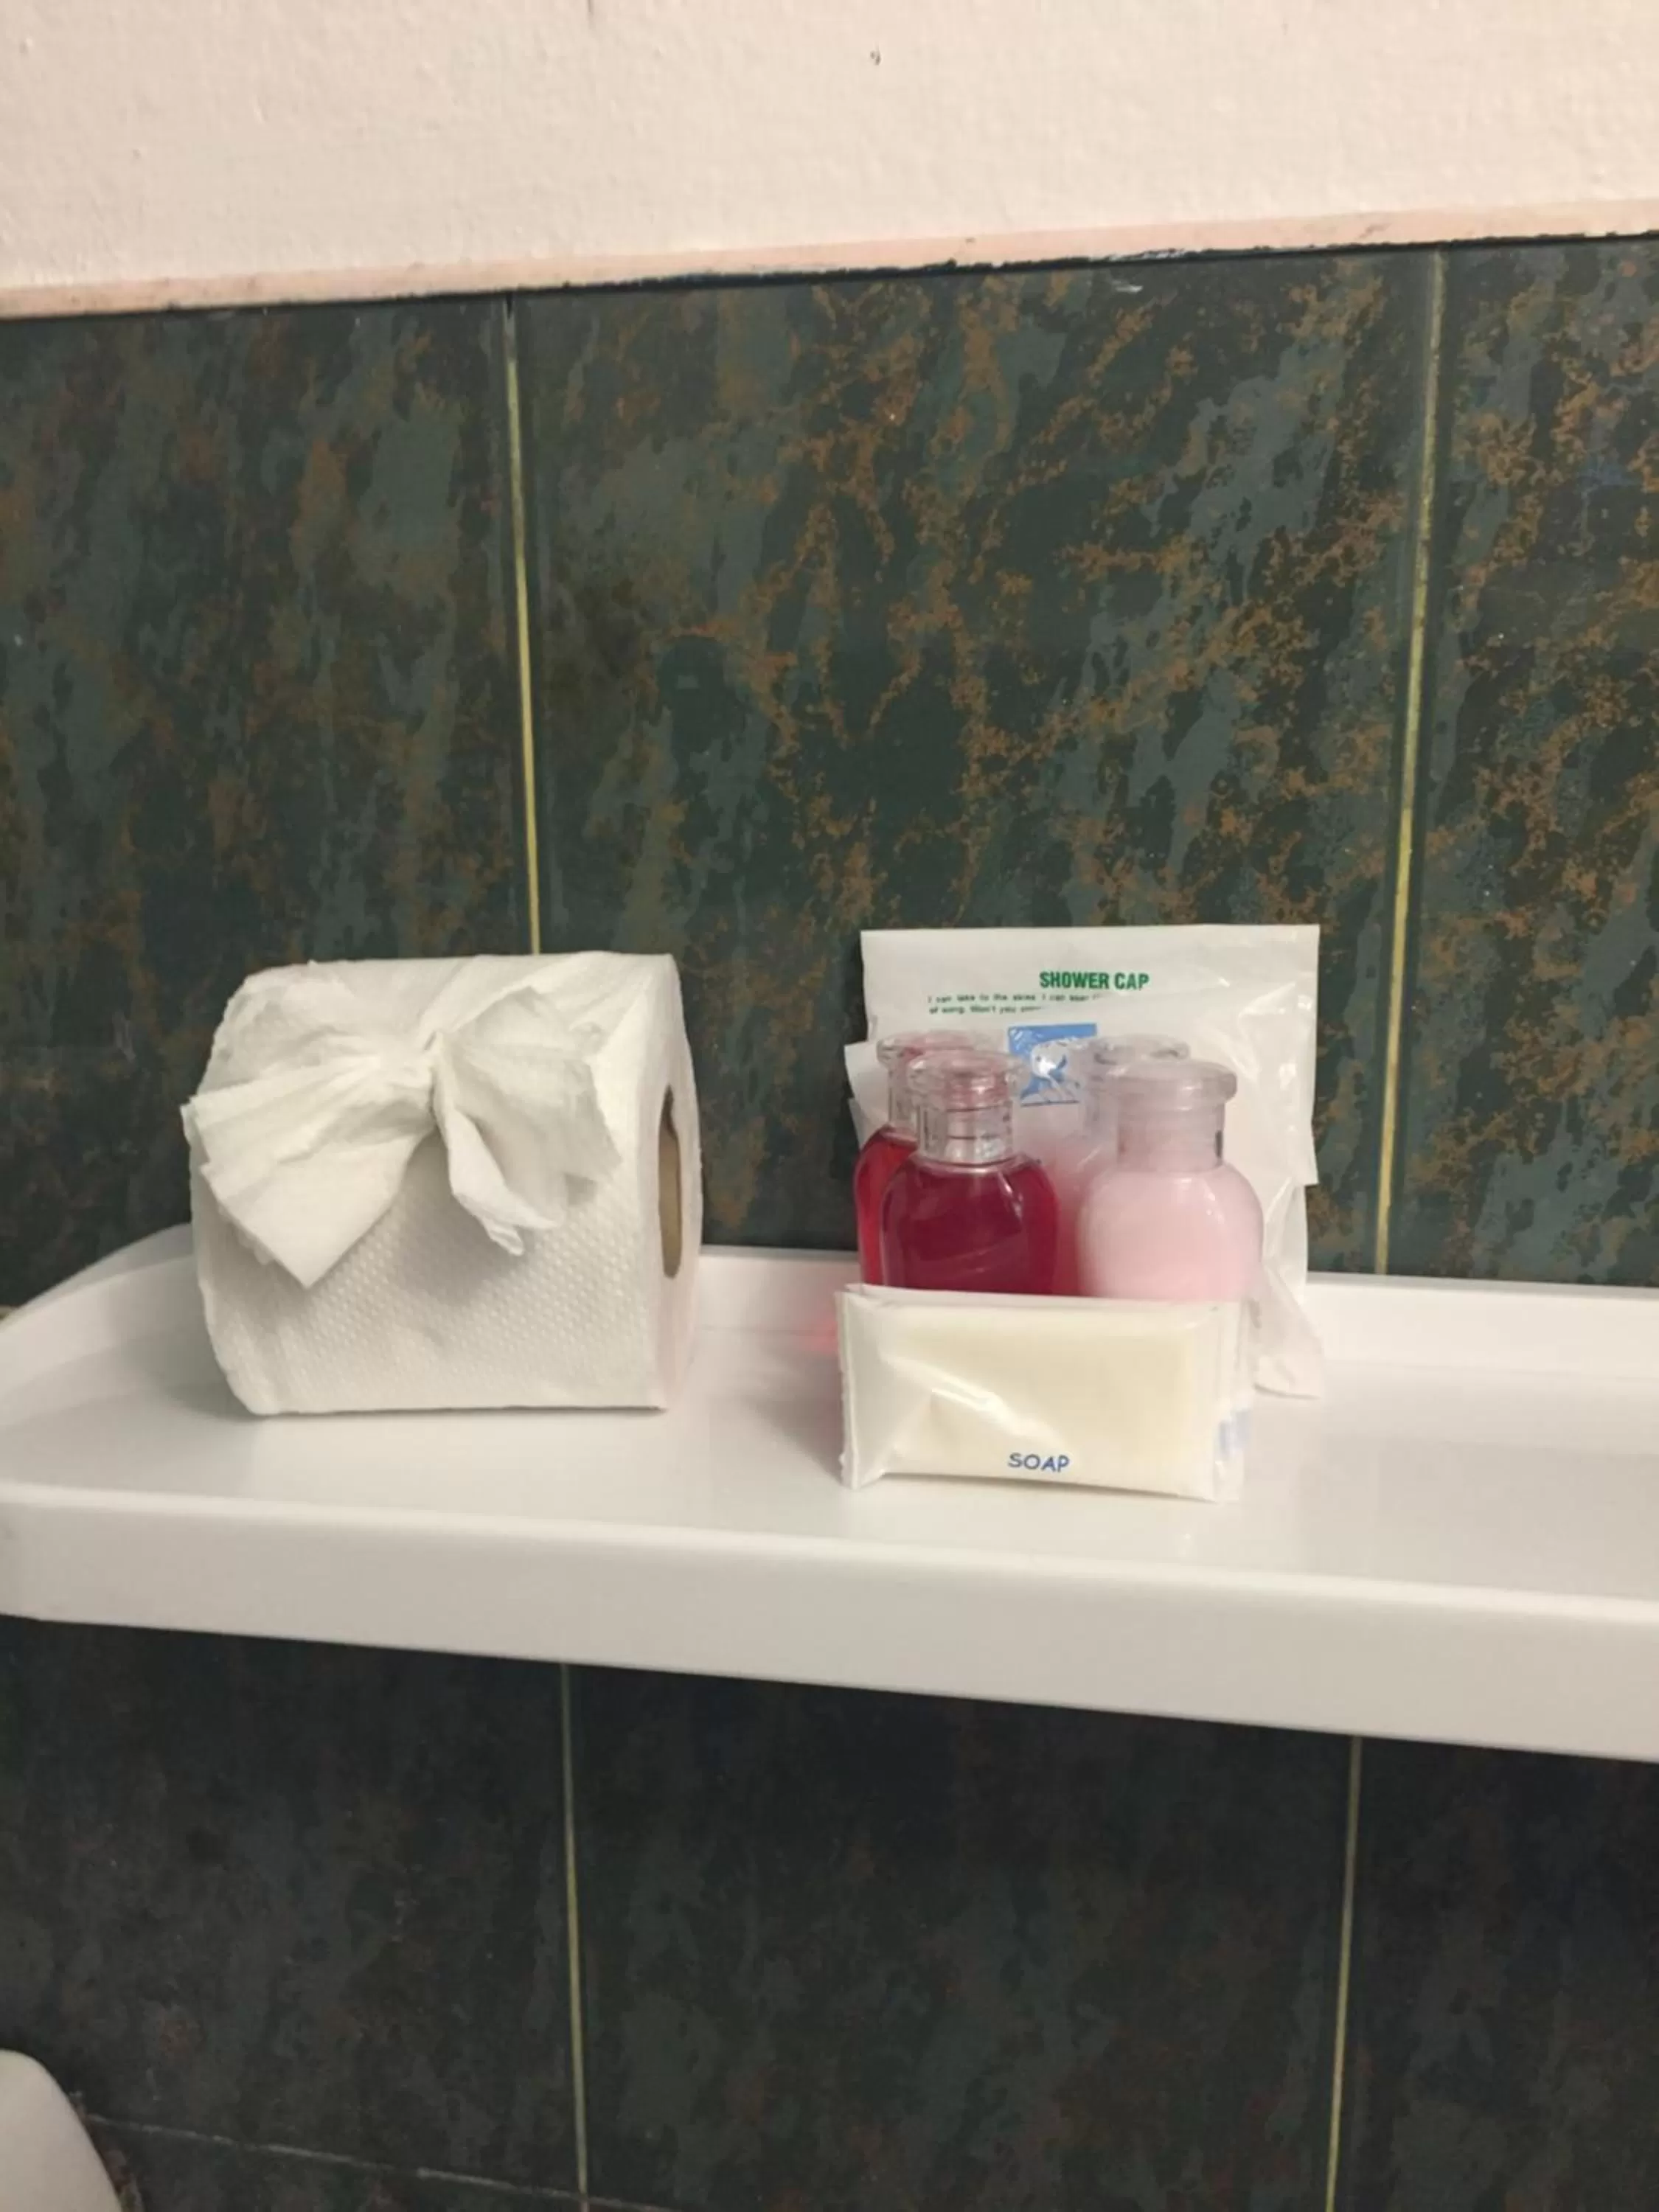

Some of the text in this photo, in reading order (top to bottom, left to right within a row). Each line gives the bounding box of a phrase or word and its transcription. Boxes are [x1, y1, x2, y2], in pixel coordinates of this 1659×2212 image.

[1039, 970, 1150, 991] SHOWER CAP
[1007, 1452, 1071, 1473] SOAP
